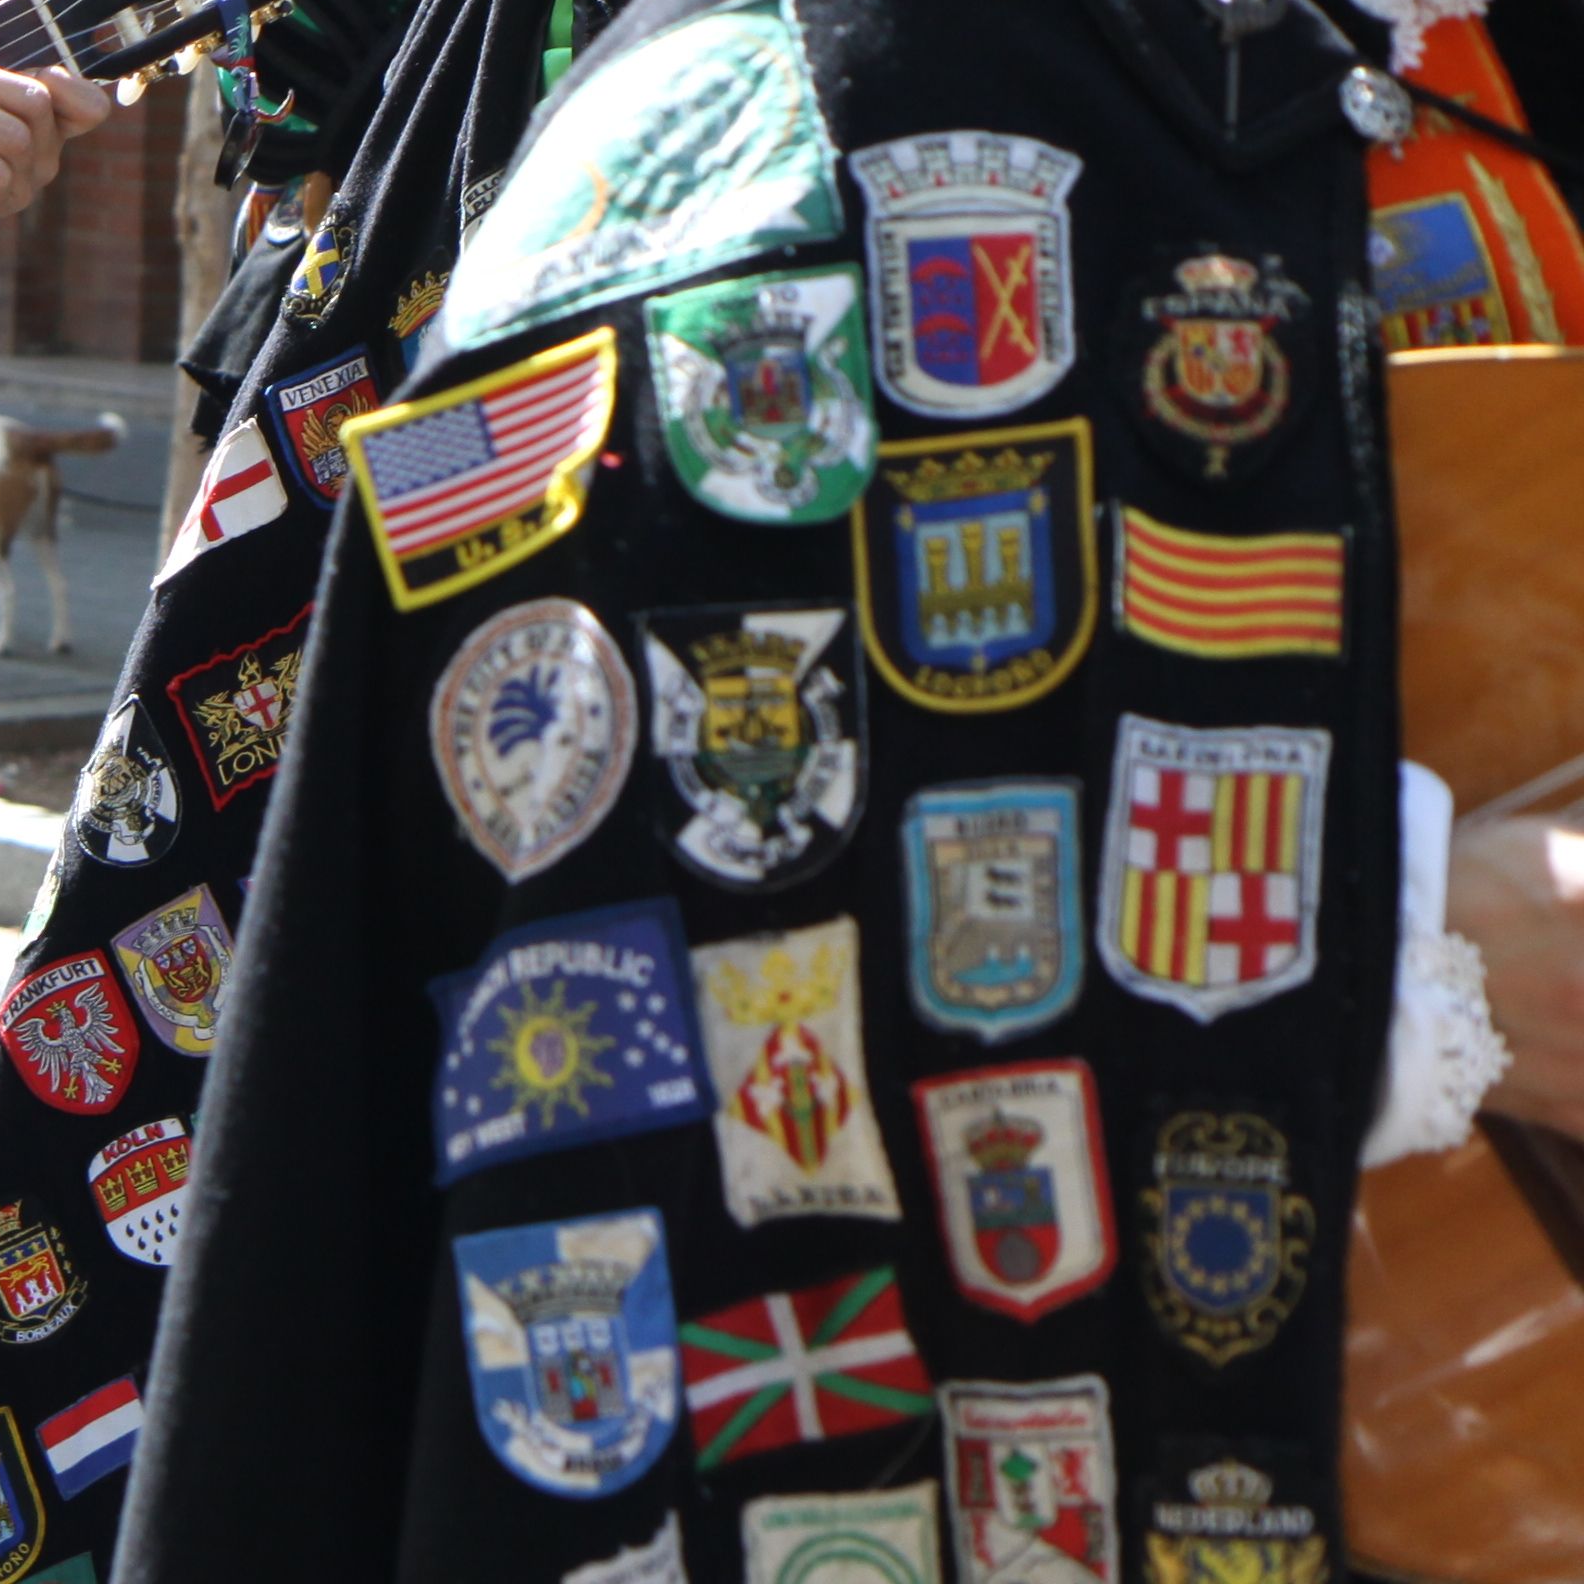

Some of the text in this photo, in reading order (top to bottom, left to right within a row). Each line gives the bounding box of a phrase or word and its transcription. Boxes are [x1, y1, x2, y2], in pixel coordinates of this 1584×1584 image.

[284, 362, 364, 407] VENEXIA
[218, 732, 288, 786] LON
[508, 940, 656, 988] REPUBLIC
[2, 959, 98, 1025] FRANKFURT
[101, 1121, 166, 1165] KÖLN
[15, 1301, 80, 1344] BORDEAUX
